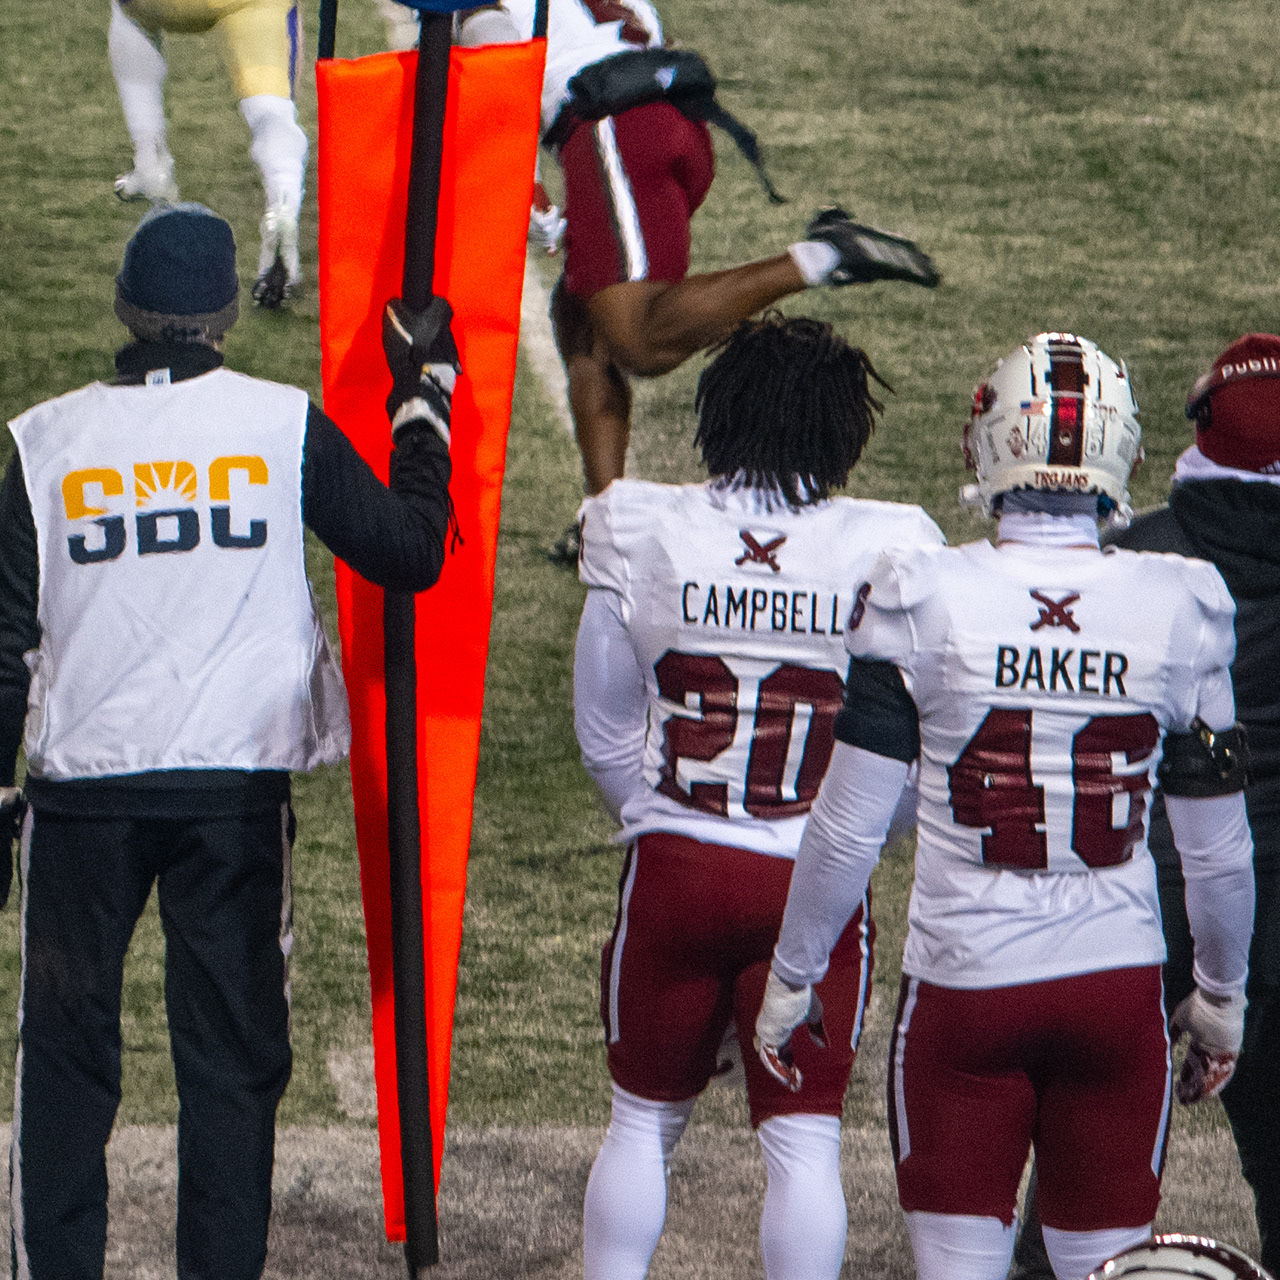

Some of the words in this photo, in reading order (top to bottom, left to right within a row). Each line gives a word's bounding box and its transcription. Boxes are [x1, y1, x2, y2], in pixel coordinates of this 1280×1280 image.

[61, 455, 270, 564] SBC
[1035, 472, 1089, 488] TROJANS
[682, 581, 844, 635] CAMPBELL
[995, 643, 1129, 697] BAKER
[653, 648, 846, 821] 20
[946, 704, 1161, 870] 46
